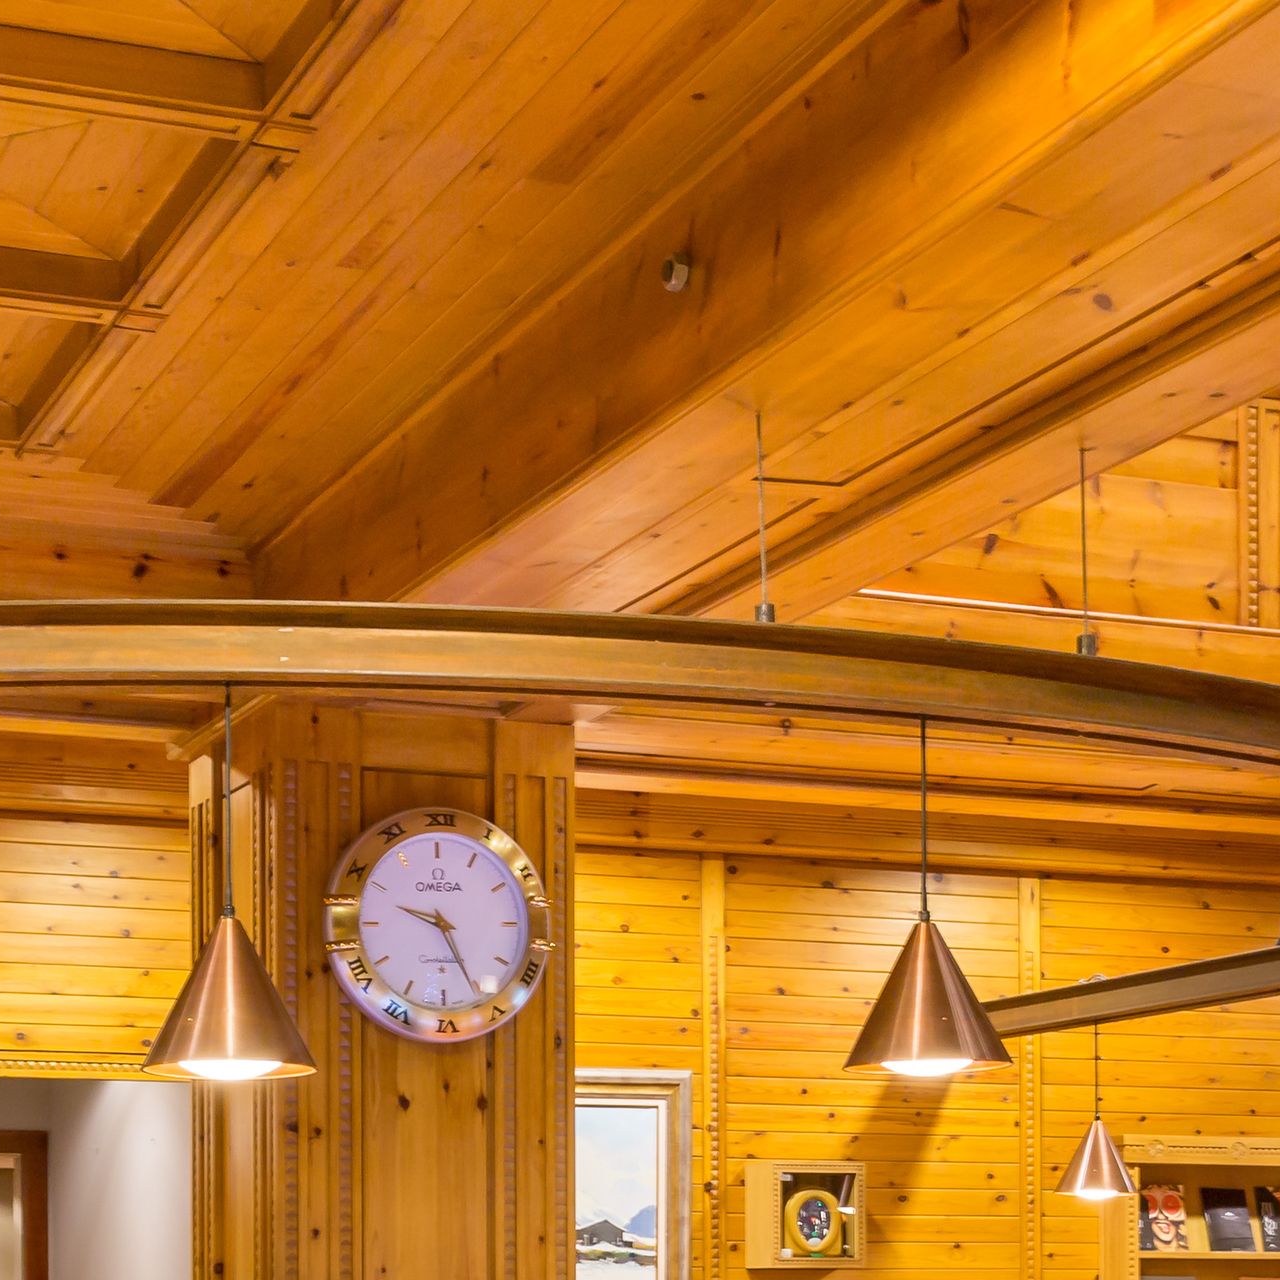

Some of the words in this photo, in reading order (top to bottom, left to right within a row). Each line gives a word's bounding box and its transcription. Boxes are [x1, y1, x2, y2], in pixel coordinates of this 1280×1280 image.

[423, 813, 457, 827] XII
[377, 822, 407, 845] XI
[346, 858, 369, 882] X
[415, 881, 463, 892] OMEGA
[488, 1005, 506, 1022] V
[435, 1018, 460, 1033] VI
